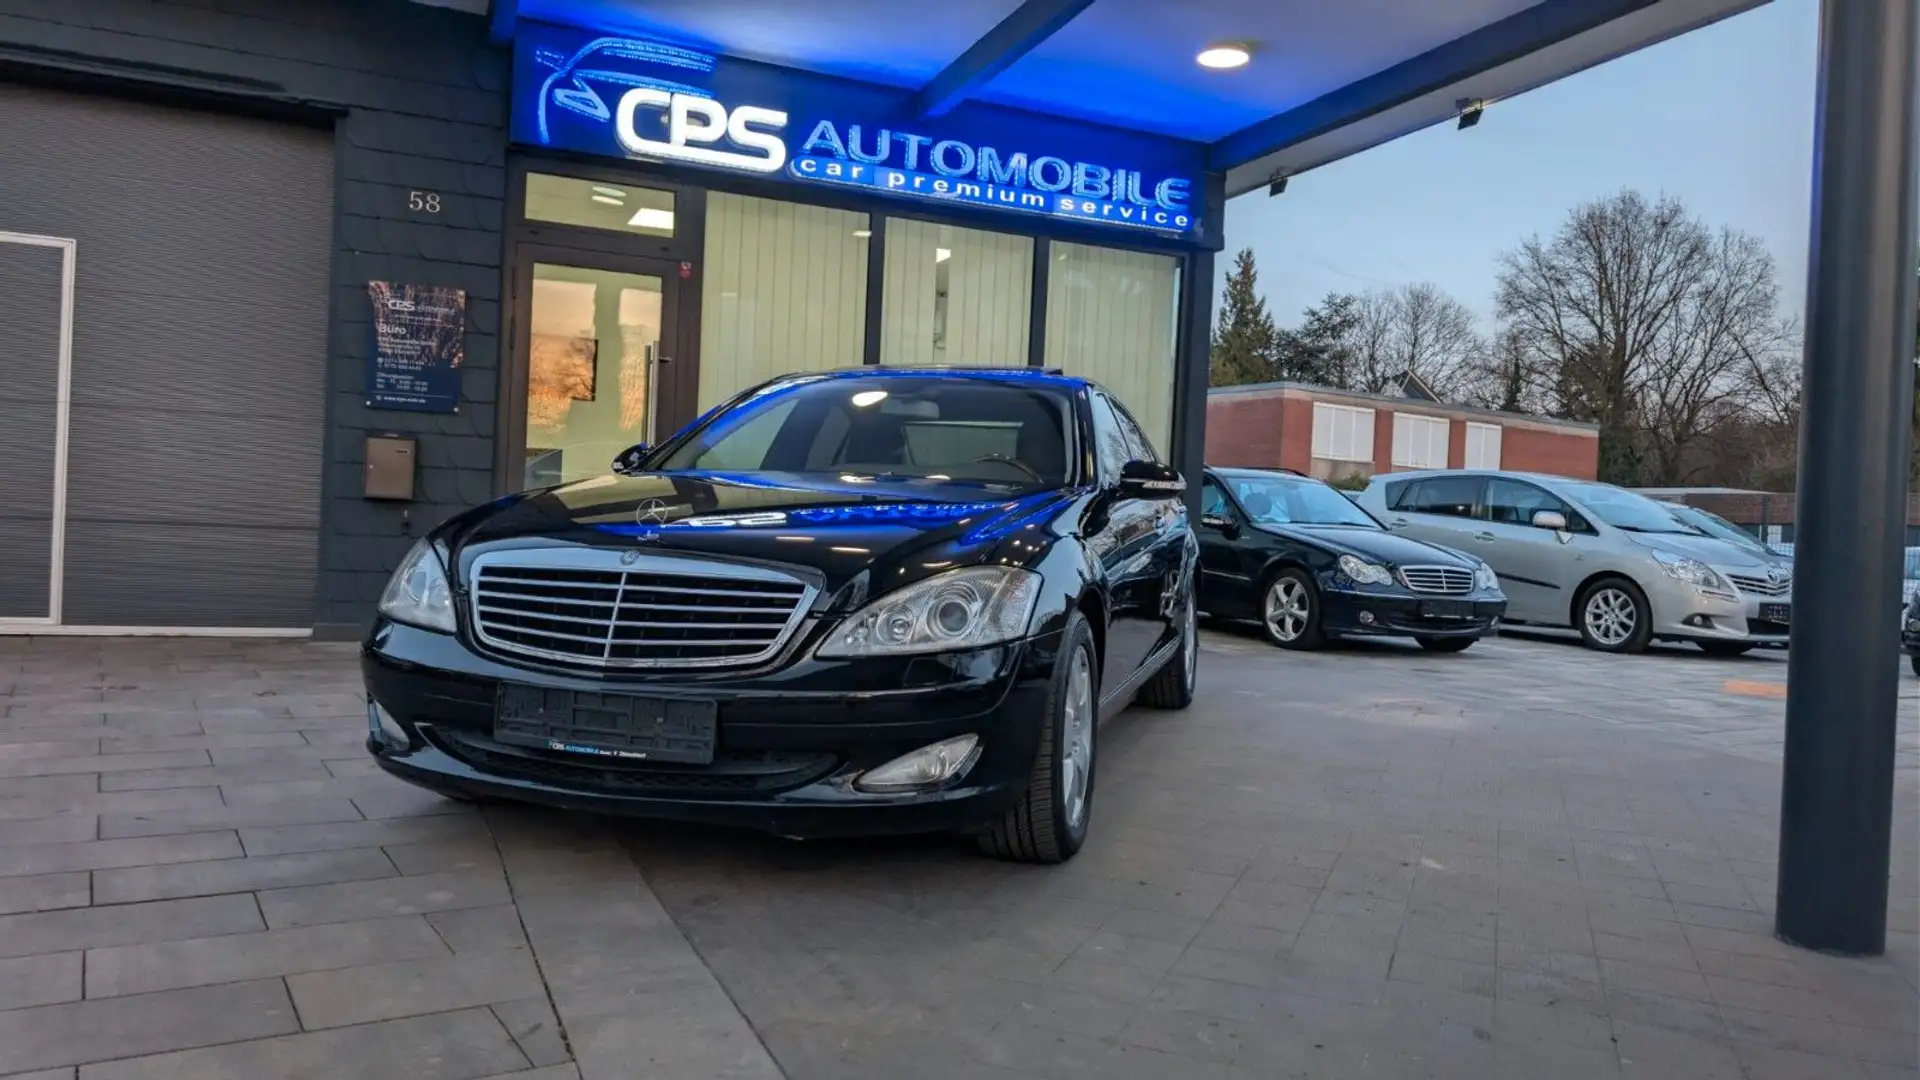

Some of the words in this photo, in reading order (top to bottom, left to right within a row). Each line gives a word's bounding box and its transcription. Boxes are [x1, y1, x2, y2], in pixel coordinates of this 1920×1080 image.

[616, 87, 788, 173] CPS
[801, 119, 1191, 210] AUTOMOBILE
[409, 191, 441, 213] 58
[800, 158, 864, 179] car
[888, 170, 1045, 207] premium
[1060, 197, 1188, 227] service
